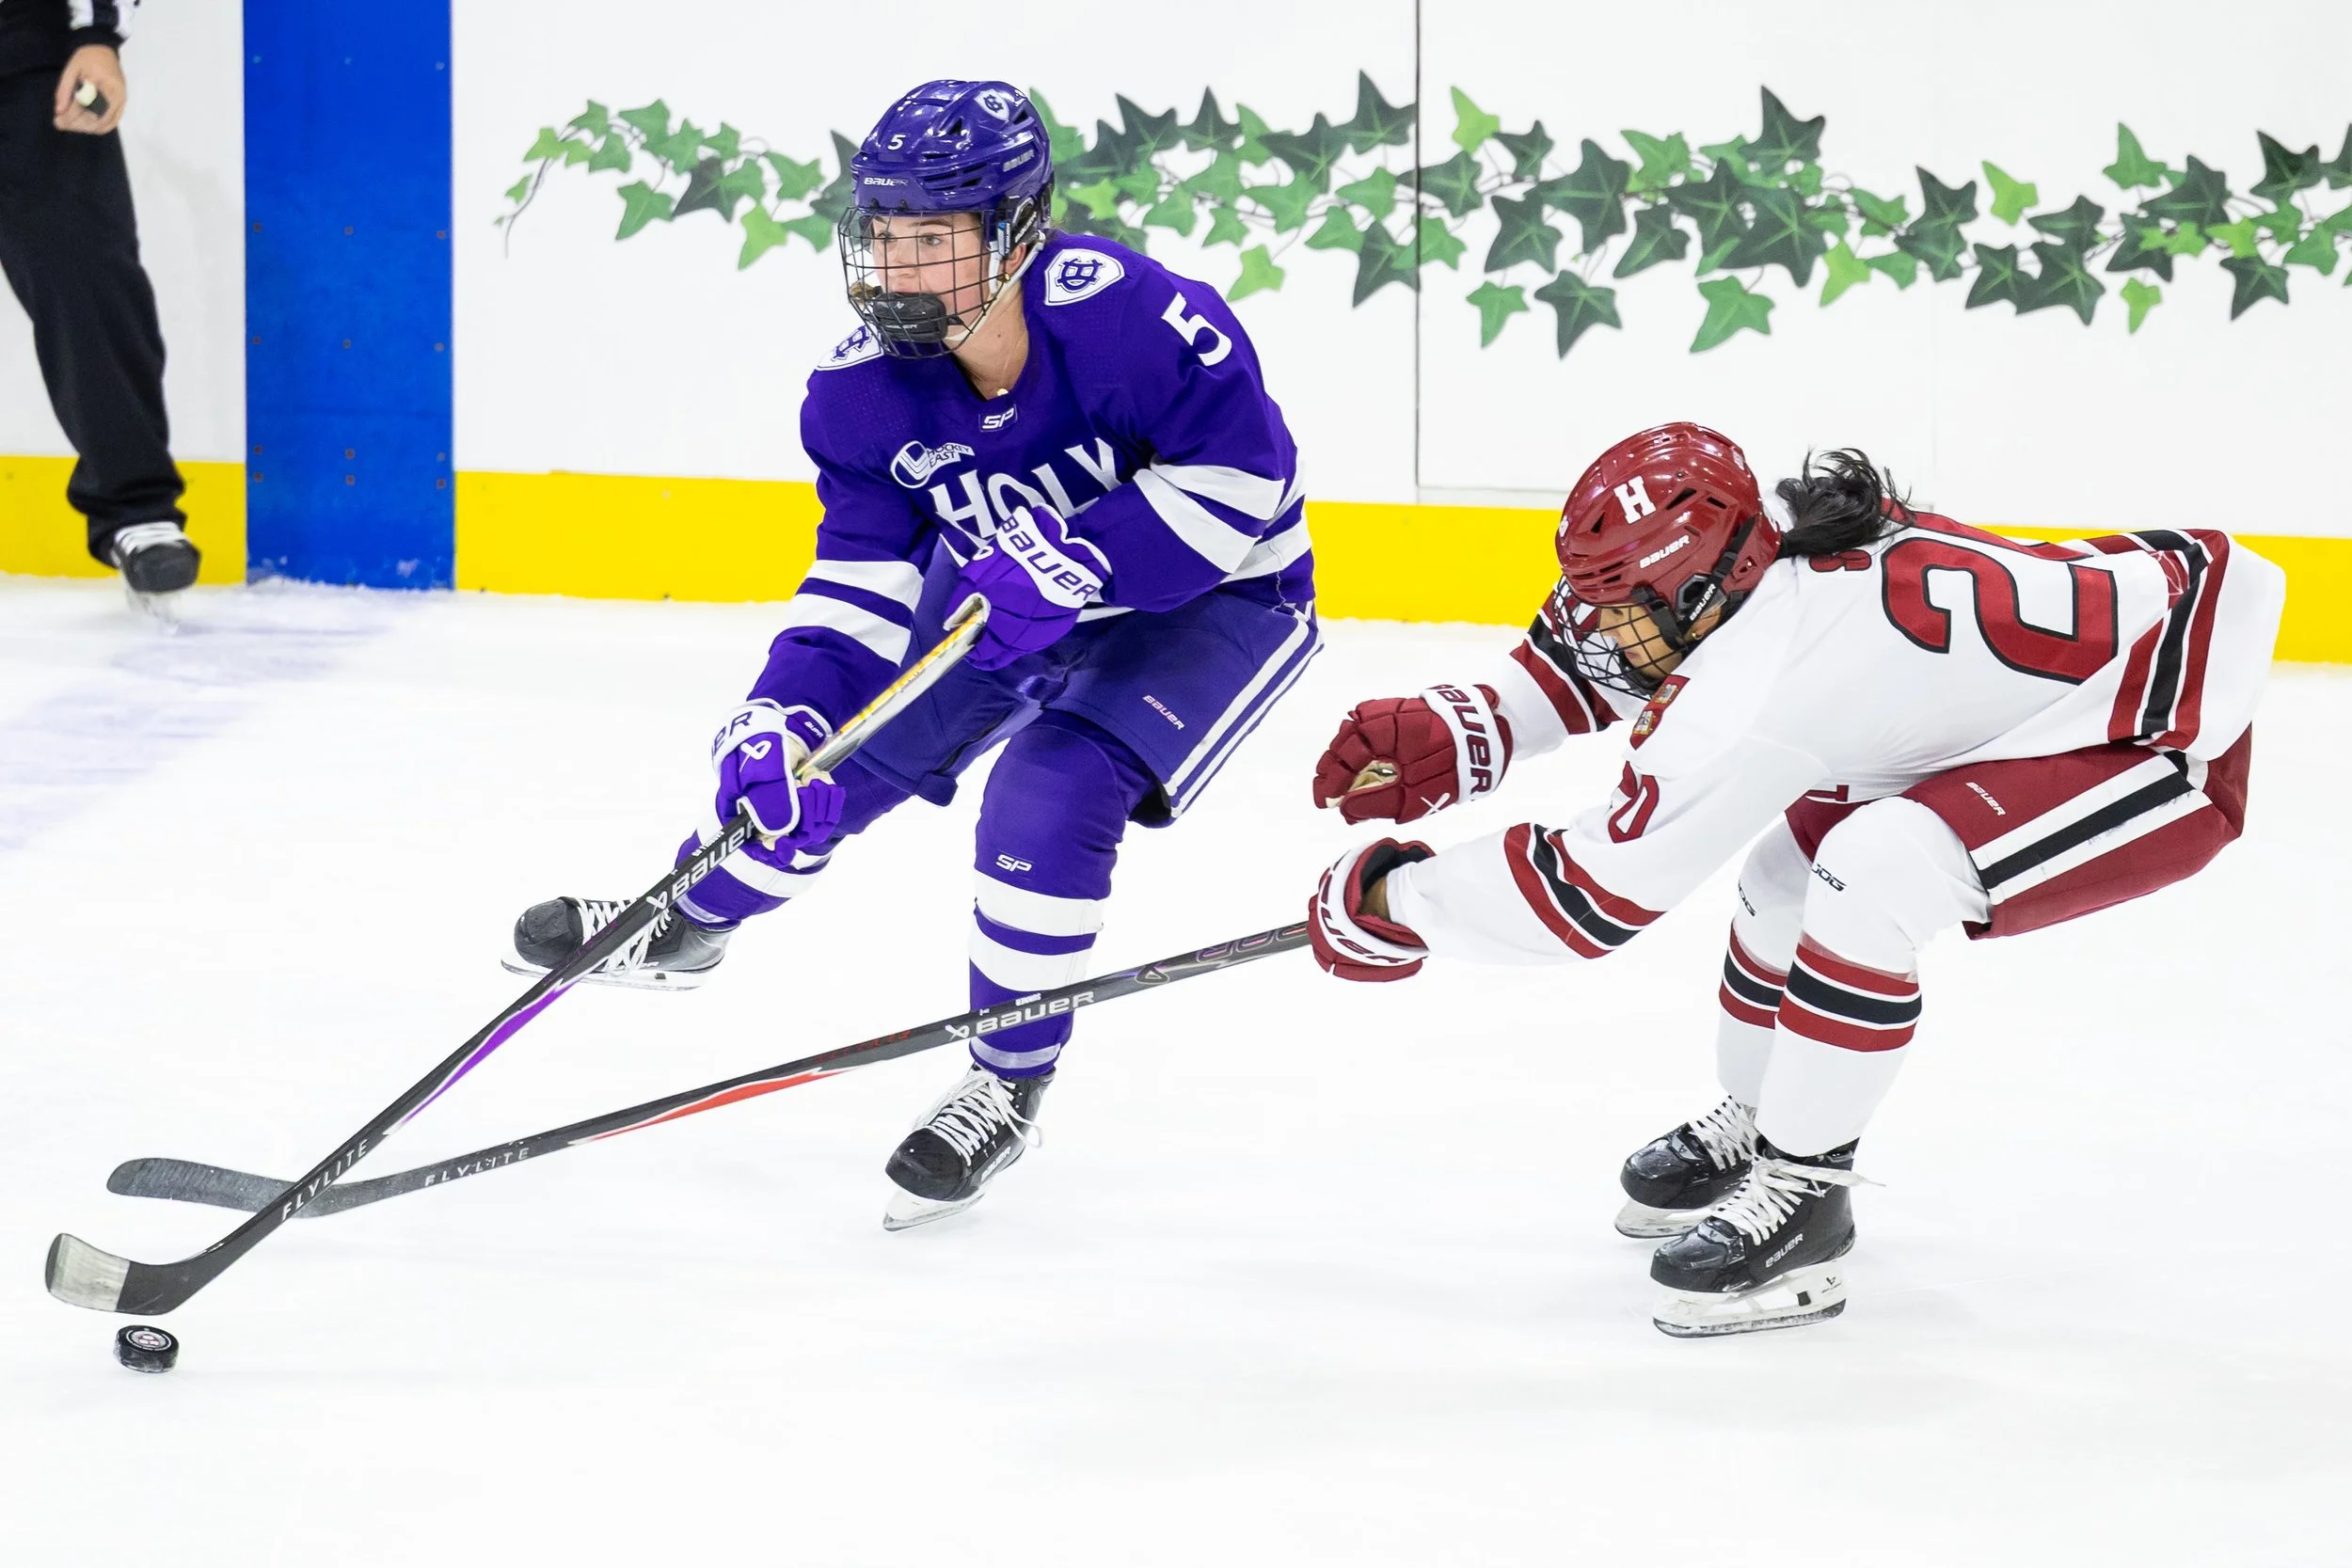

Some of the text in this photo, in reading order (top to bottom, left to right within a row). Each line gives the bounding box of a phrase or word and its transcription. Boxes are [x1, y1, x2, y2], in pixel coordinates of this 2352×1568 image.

[887, 135, 906, 150] 5
[1160, 291, 1232, 367] 5
[982, 407, 1014, 429] SP
[927, 443, 970, 458] HOCKEY
[930, 451, 956, 468] EAST
[928, 436, 1122, 539] HOLY
[1613, 475, 1657, 525] H
[997, 854, 1031, 872] SP
[282, 1138, 369, 1222] FLYLITE
[424, 1147, 529, 1187] FLYLITE
